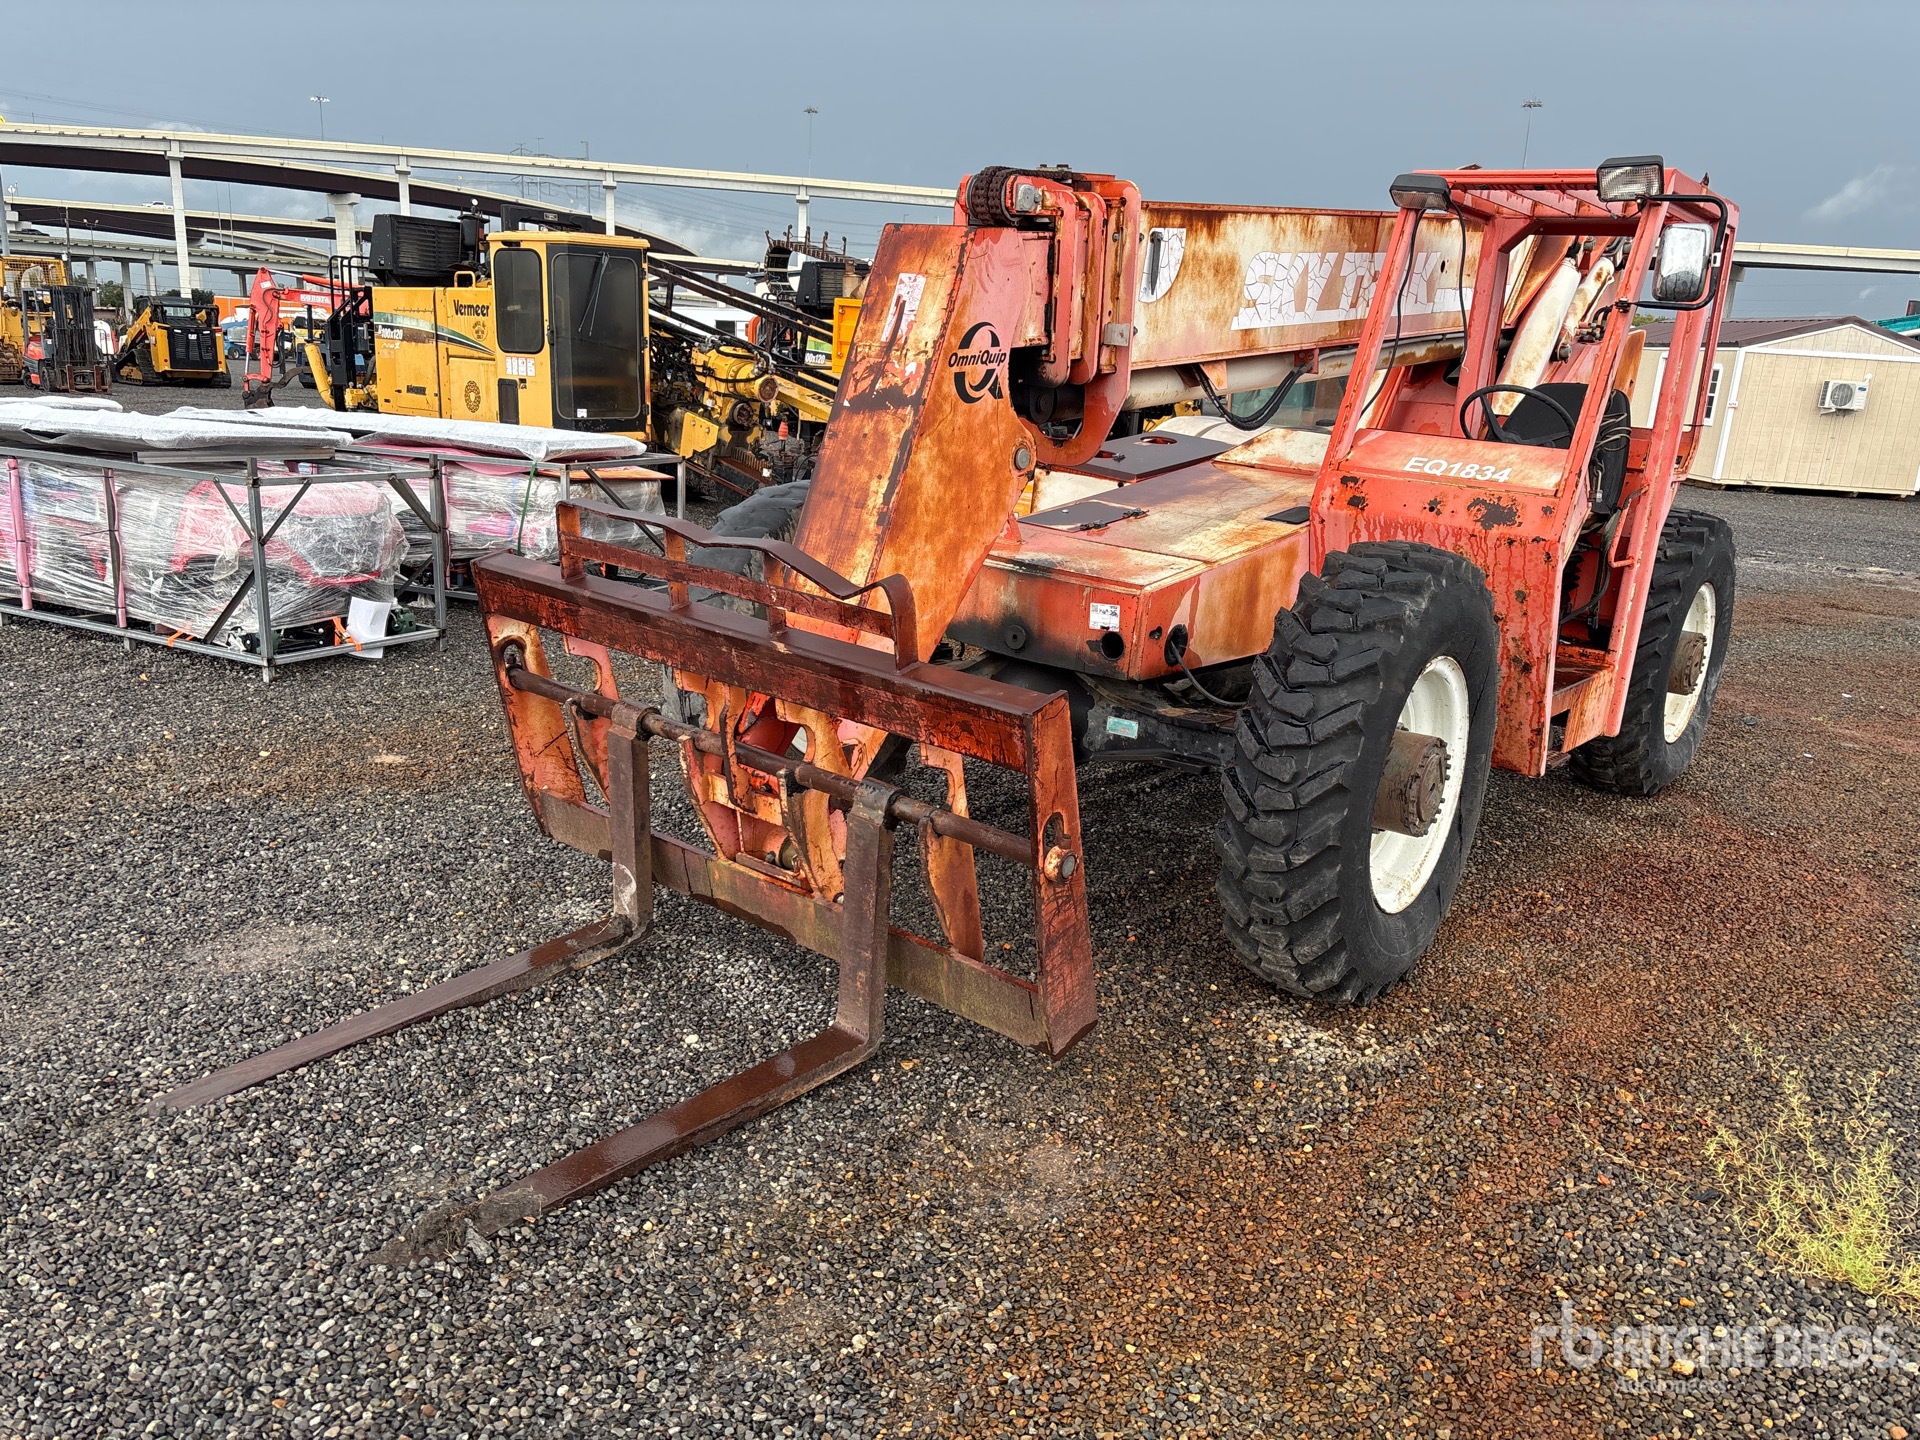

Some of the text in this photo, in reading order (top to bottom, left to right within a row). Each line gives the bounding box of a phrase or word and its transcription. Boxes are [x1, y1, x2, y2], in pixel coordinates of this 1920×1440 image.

[453, 299, 490, 317] Vermeer
[804, 353, 826, 365] 00x120
[948, 349, 1007, 367] OmniQuip
[1402, 456, 1513, 482] EQ1834
